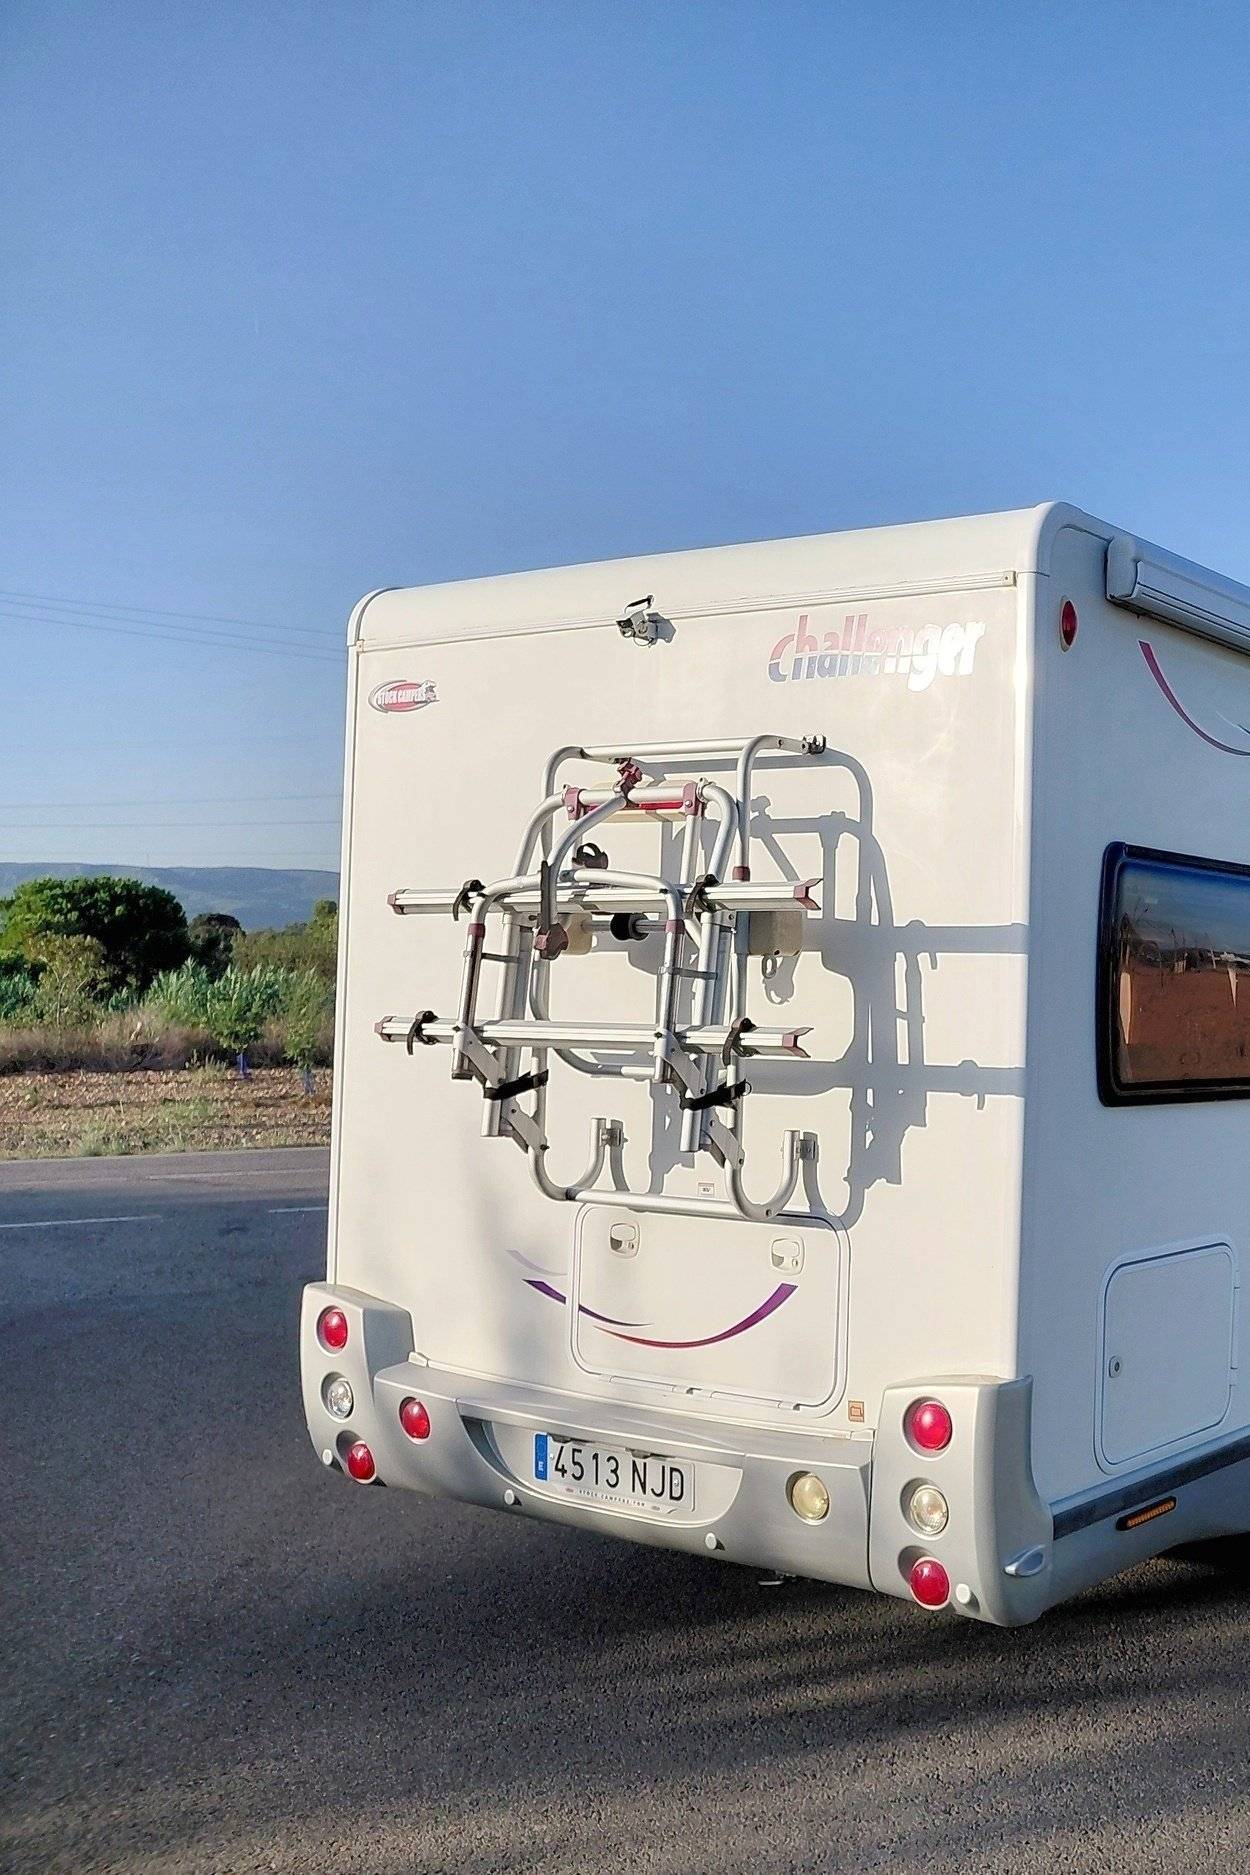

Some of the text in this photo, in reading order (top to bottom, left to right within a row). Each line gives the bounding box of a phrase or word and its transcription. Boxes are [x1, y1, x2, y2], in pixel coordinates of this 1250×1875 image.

[768, 614, 986, 692] challenger
[553, 1445, 685, 1502] 4513 NJD
